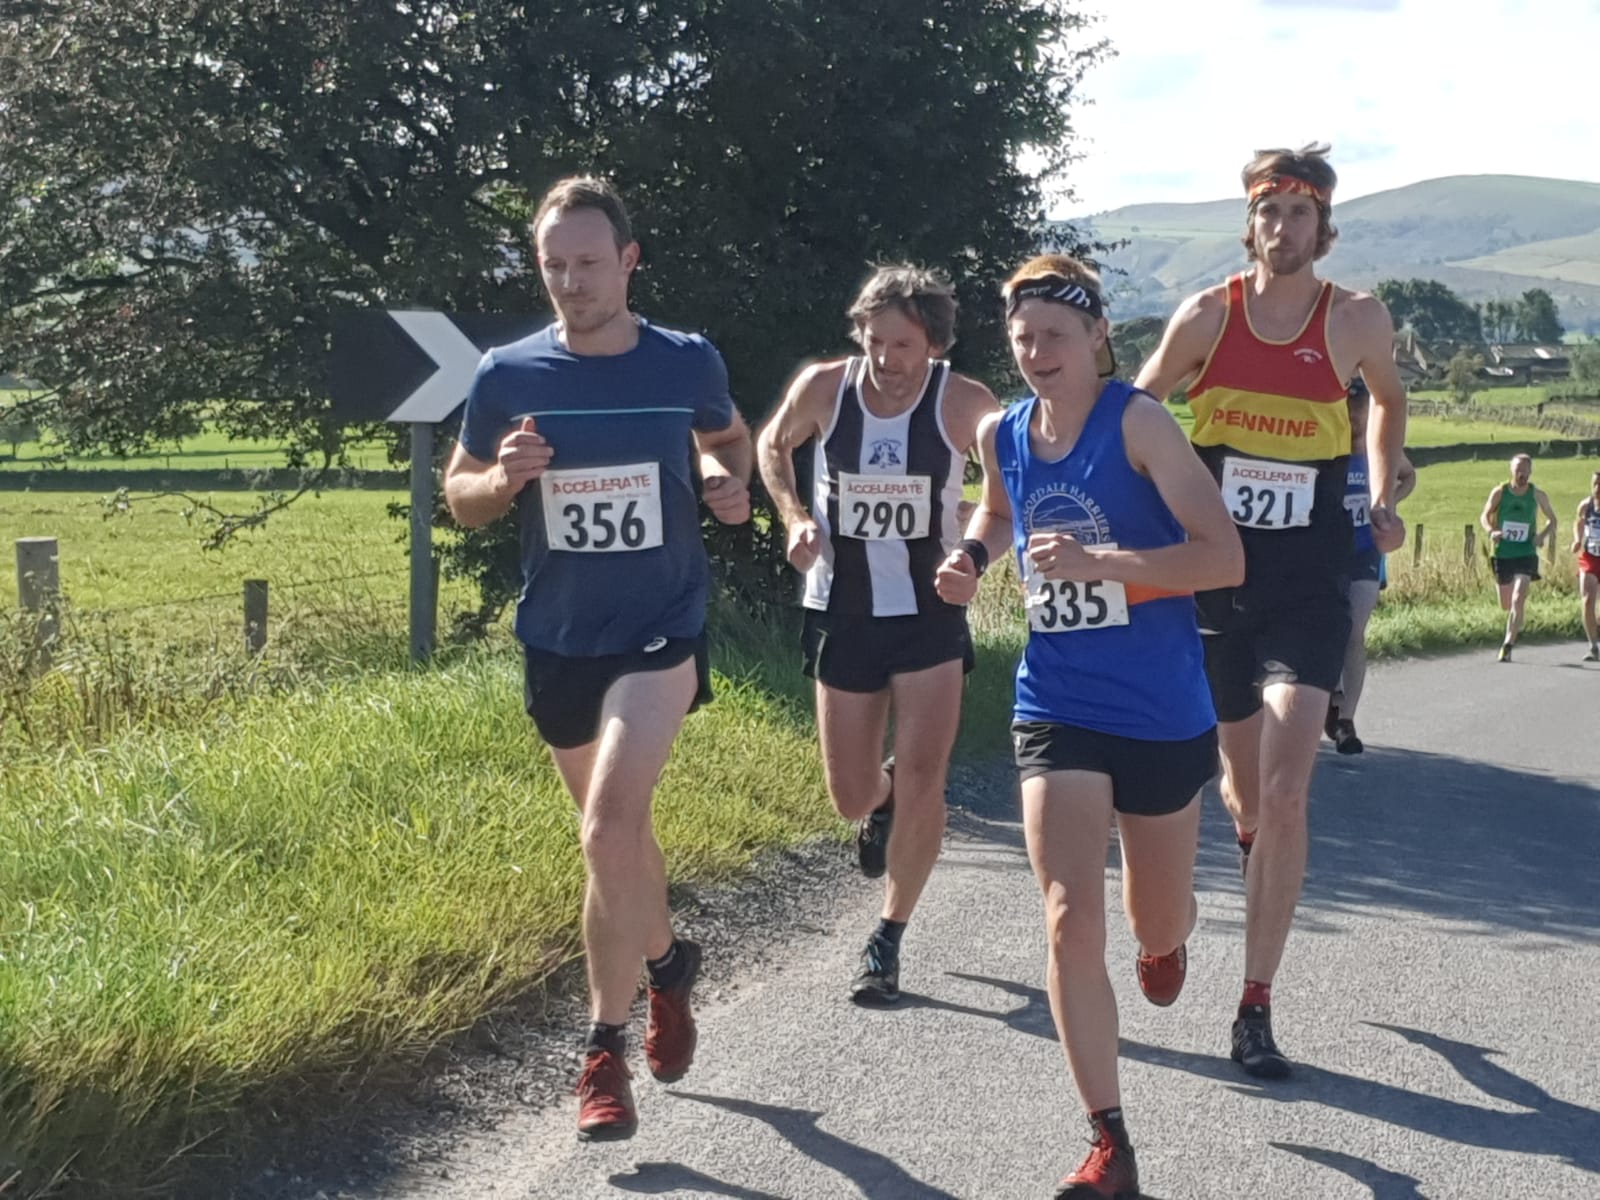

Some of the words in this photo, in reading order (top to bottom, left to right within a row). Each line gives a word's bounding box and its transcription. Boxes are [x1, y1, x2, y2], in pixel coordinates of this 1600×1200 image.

[1211, 408, 1319, 437] PENNINE
[552, 474, 651, 495] ACCELERATE
[847, 483, 924, 495] ACCELERATE
[1232, 467, 1309, 484] ACCELERATE
[852, 501, 916, 538] 290
[1069, 485, 1111, 543] HARRIERS
[1232, 485, 1294, 526] 321
[562, 500, 646, 549] 356
[1040, 580, 1108, 629] 335
